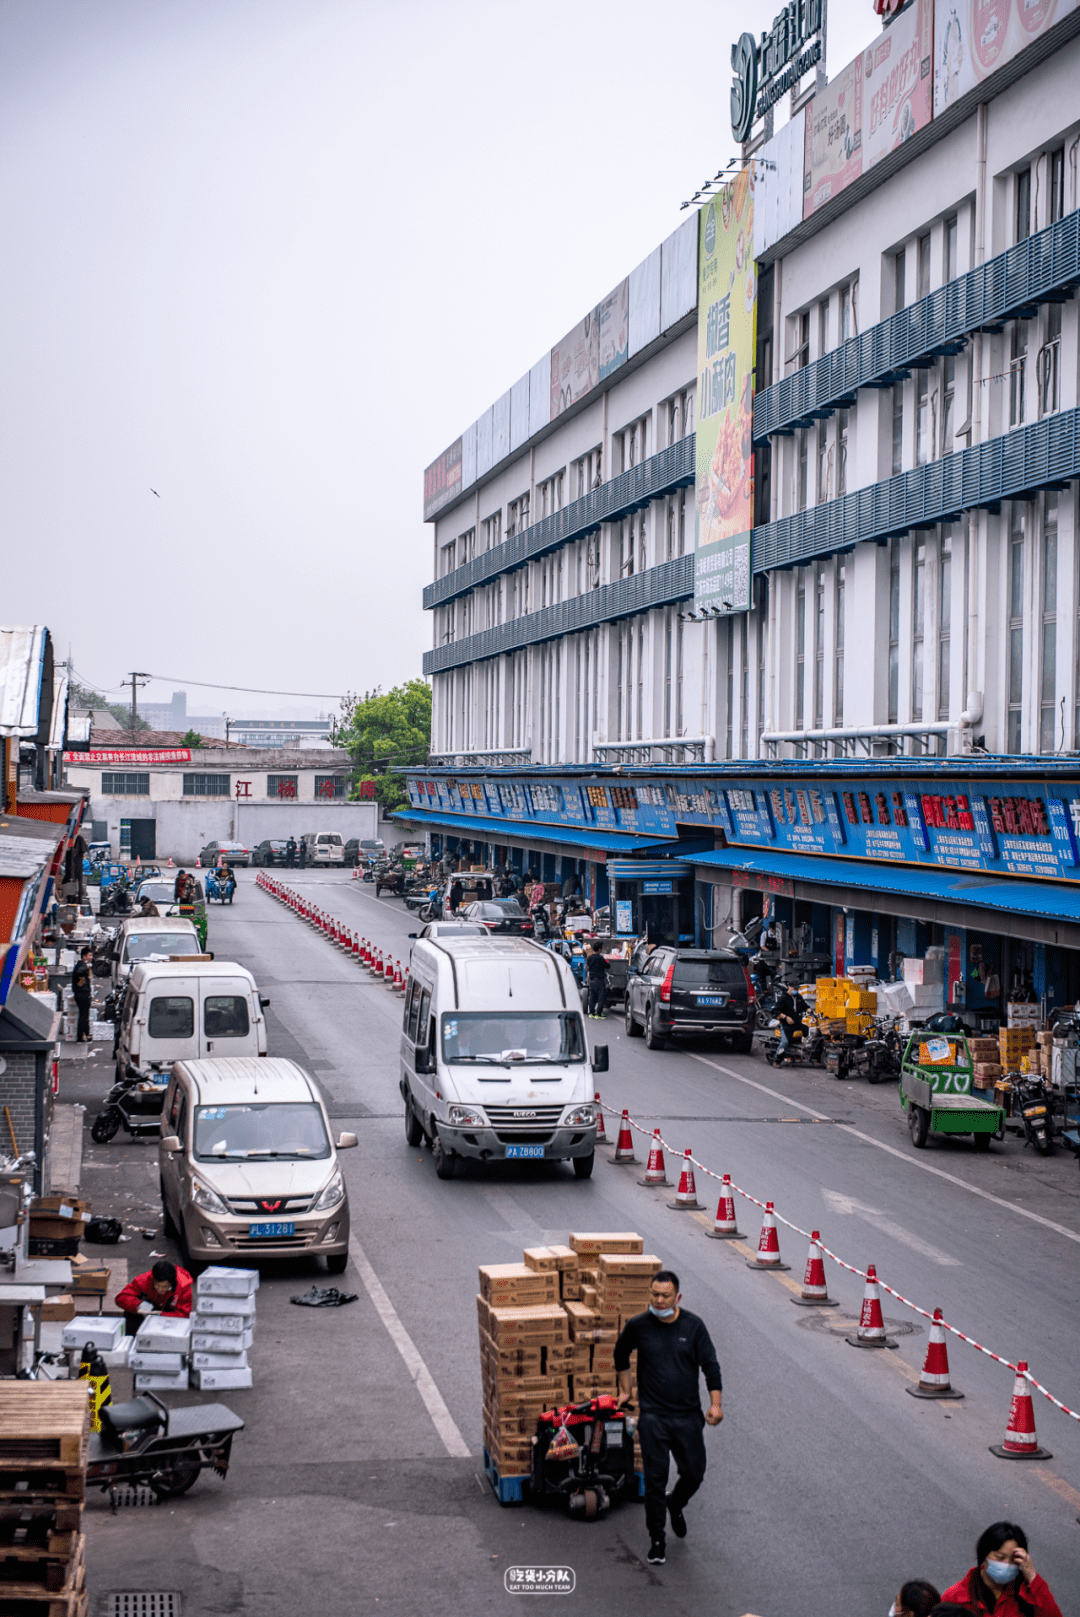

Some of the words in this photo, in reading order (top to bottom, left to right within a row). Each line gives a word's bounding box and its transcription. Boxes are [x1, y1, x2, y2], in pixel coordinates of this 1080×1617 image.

[699, 350, 737, 422] 小酥肉
[235, 779, 378, 799] 江杨冷库
[1052, 825, 1069, 840] 1070
[861, 1298, 873, 1327] 江杨农产
